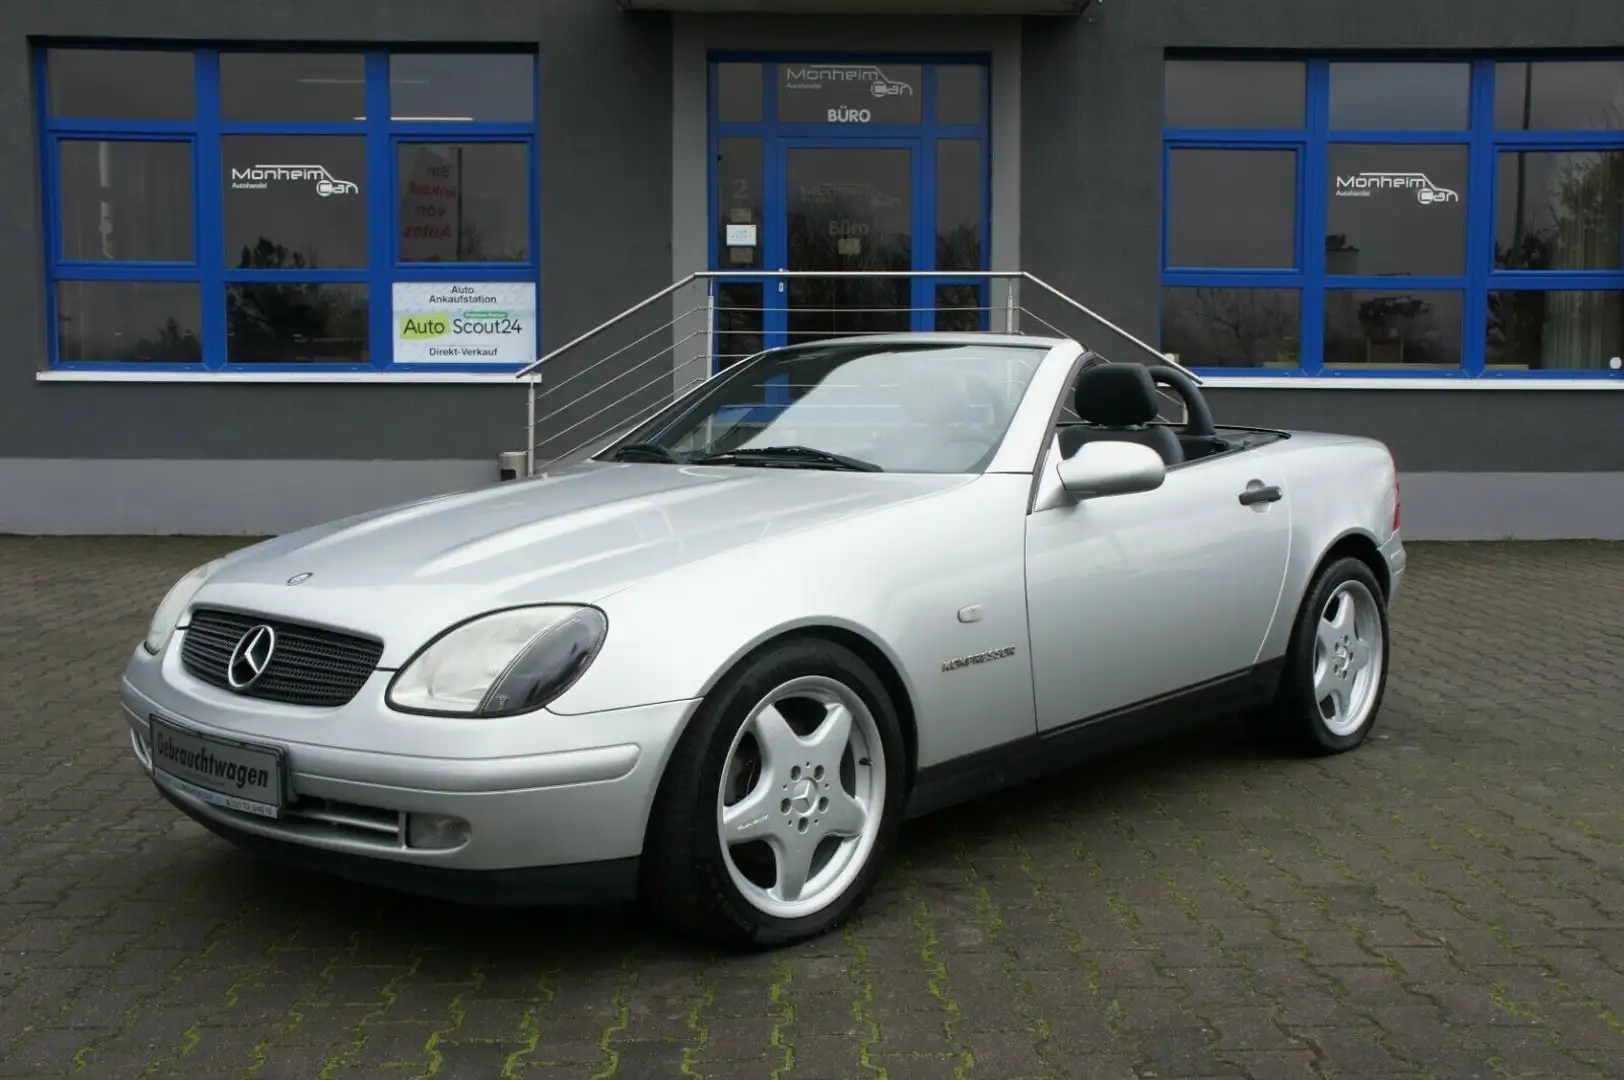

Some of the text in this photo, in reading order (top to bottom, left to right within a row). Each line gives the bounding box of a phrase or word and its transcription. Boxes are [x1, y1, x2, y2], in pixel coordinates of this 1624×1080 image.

[787, 68, 878, 80] Monheim
[827, 105, 871, 122] BÜRO
[232, 168, 324, 180] Monheim
[316, 180, 354, 197] Car
[731, 178, 749, 199] 2
[1336, 175, 1426, 188] Monheim
[1418, 188, 1455, 204] Car
[451, 285, 475, 294] Auto
[429, 295, 497, 304] Ankaufstation
[403, 318, 522, 334] Auto Scout24
[429, 347, 498, 356] Direkt-Verkauf
[157, 732, 270, 788] Gebrauchtwagen
